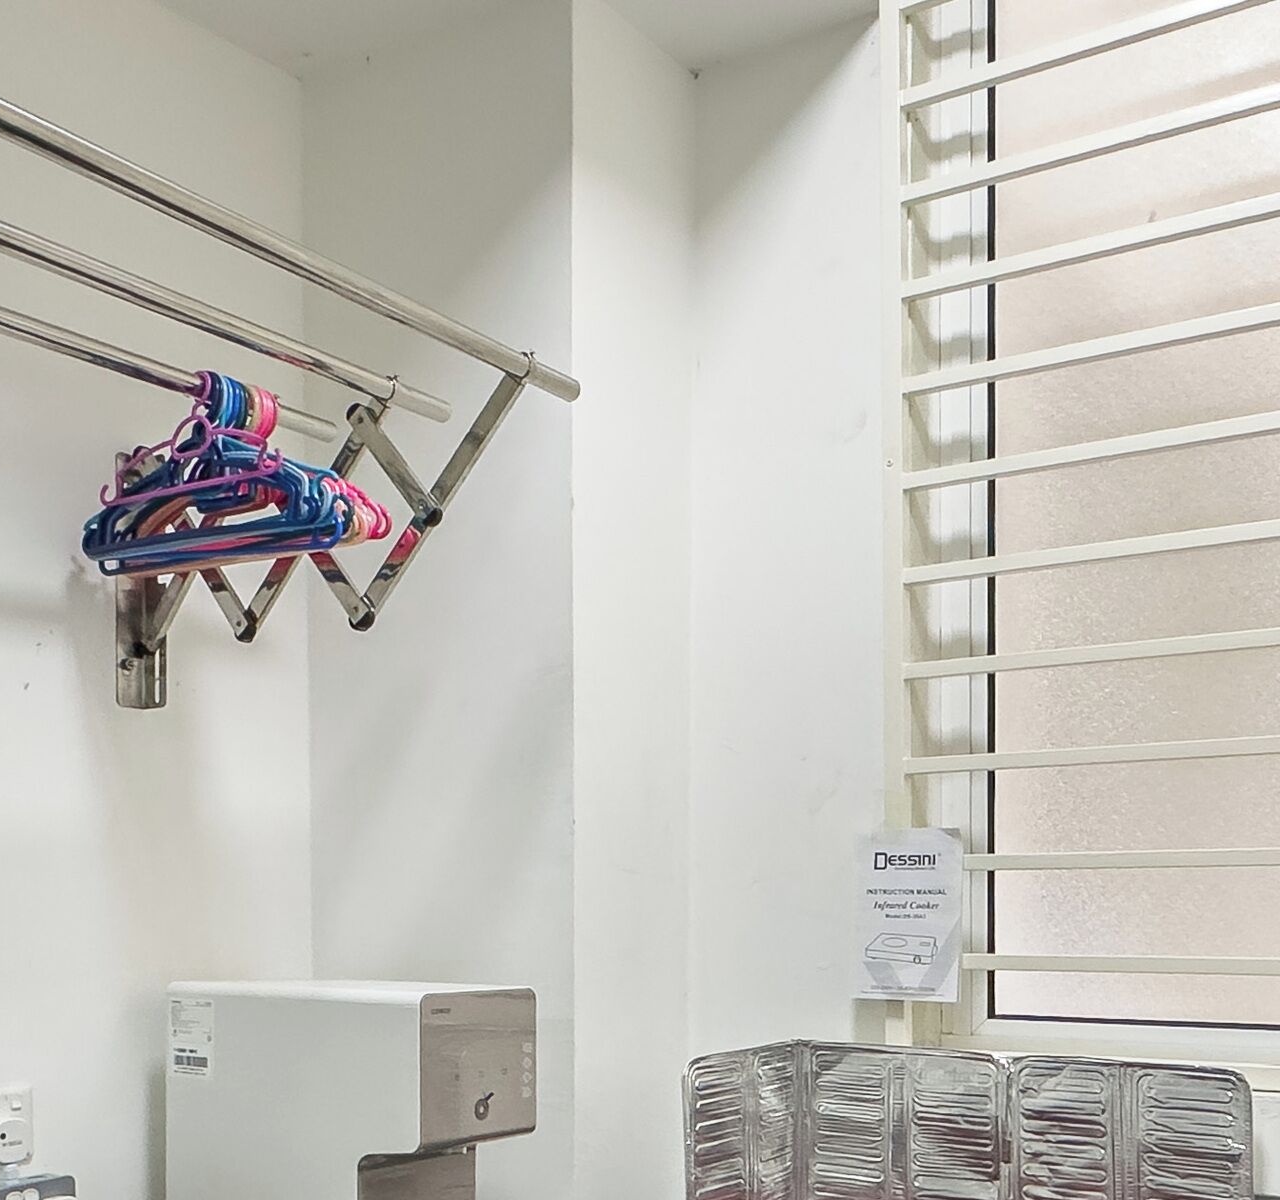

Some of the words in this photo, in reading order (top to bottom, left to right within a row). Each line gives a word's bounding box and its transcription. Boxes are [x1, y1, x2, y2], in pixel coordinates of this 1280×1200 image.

[866, 888, 915, 896] INSTRUCTION
[916, 888, 947, 896] MANUAL
[873, 901, 908, 910] Infrared
[910, 901, 940, 910] Cooker
